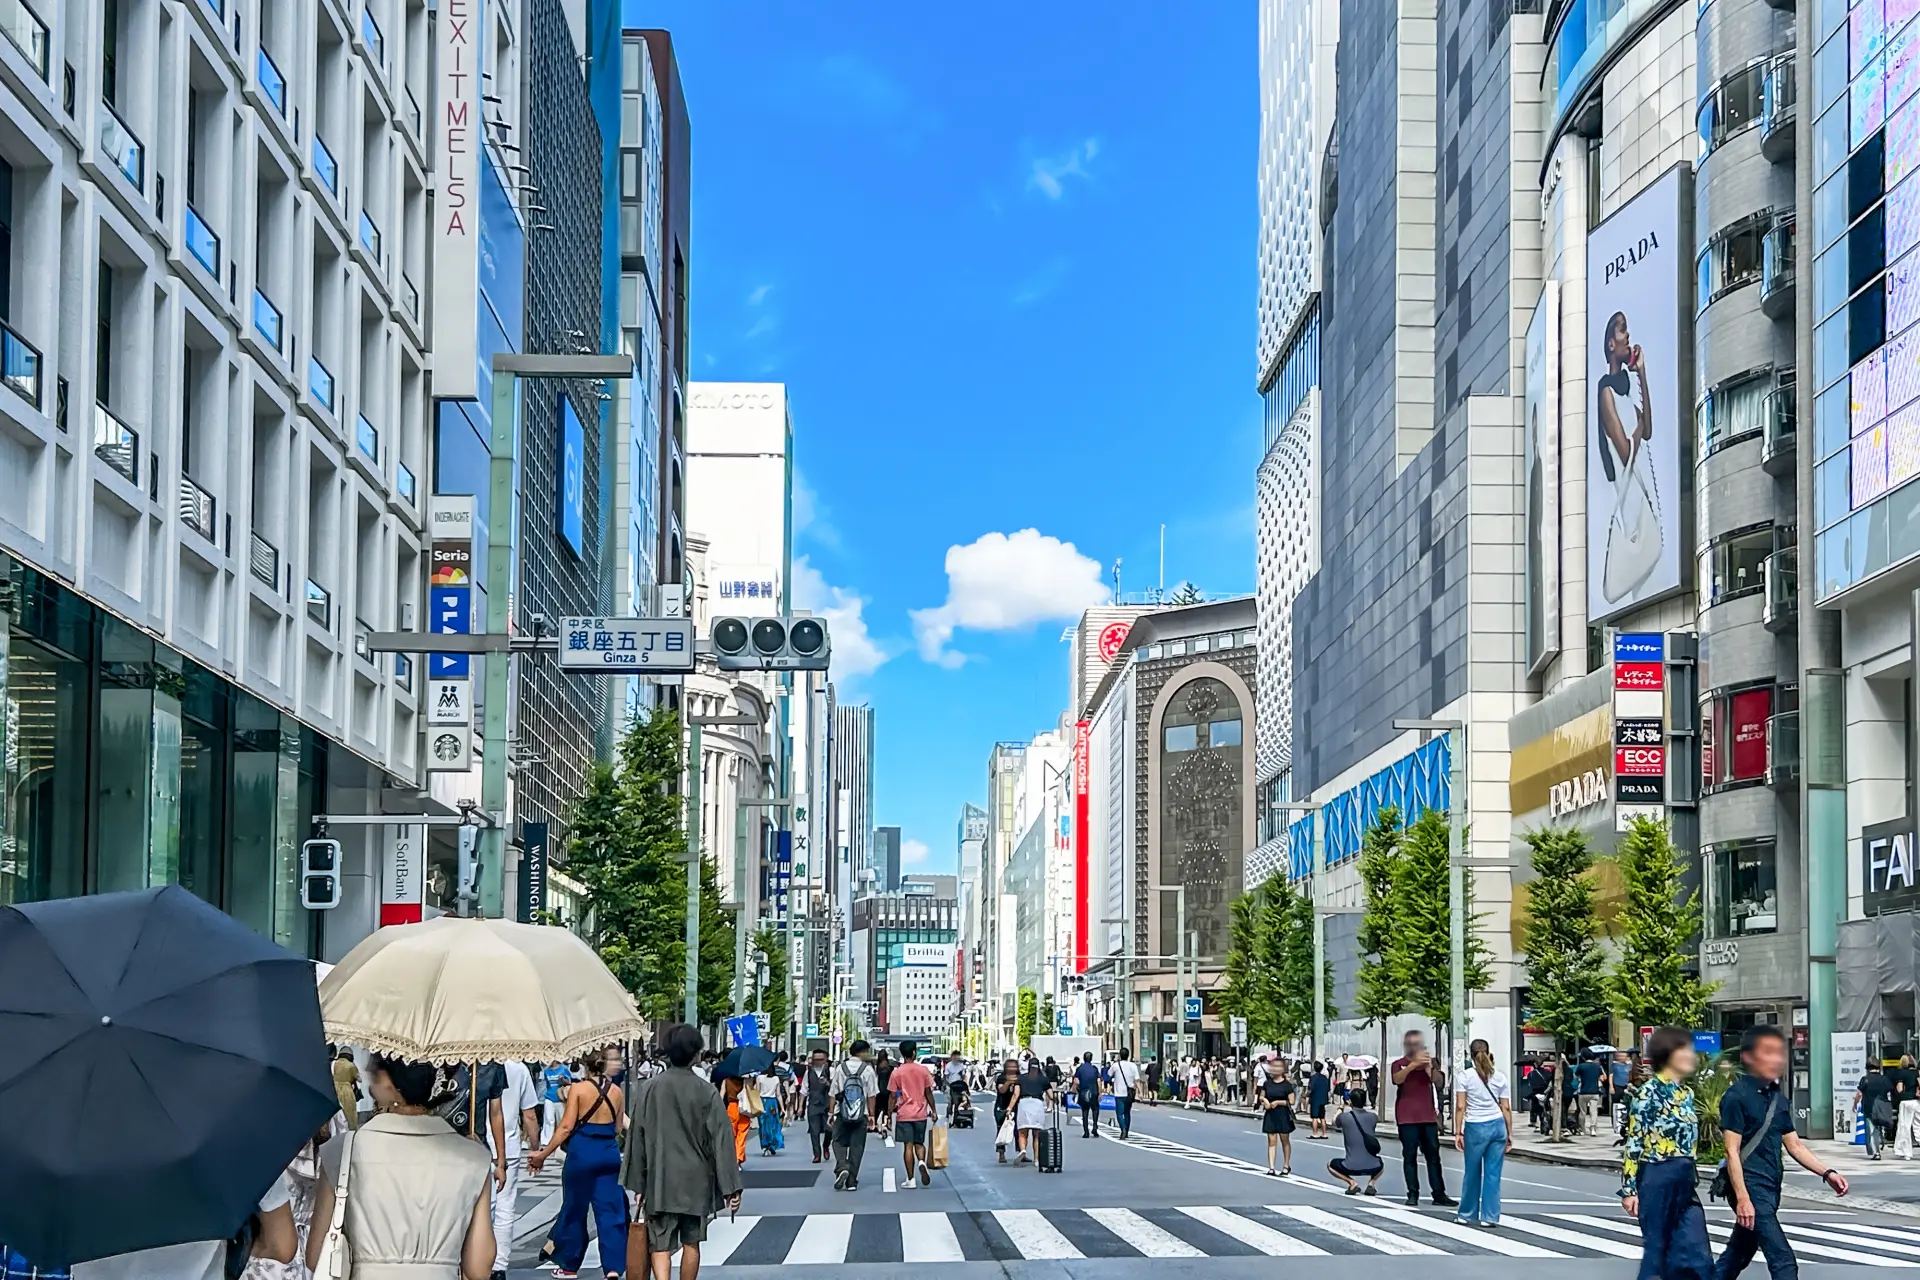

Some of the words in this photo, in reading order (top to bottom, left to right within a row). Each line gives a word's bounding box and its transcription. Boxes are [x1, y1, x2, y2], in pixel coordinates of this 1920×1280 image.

[447, 0, 468, 236] EXITMELSA
[1604, 231, 1660, 286] PRADA
[434, 550, 469, 561] Seria
[442, 596, 459, 669] PLAA
[568, 618, 605, 630] 中央区
[568, 630, 685, 652] 銀座五丁目
[603, 652, 636, 664] Ginza
[641, 652, 649, 663] 5
[1078, 727, 1087, 795] MITSUKOSHI
[1624, 750, 1661, 763] ECC
[1549, 767, 1608, 818] PRADA
[1621, 785, 1658, 793] PRADA
[795, 807, 807, 877] 教文館
[395, 843, 409, 900] SoftBank
[529, 845, 541, 925] WASHINGTO
[908, 947, 945, 956] Brillia
